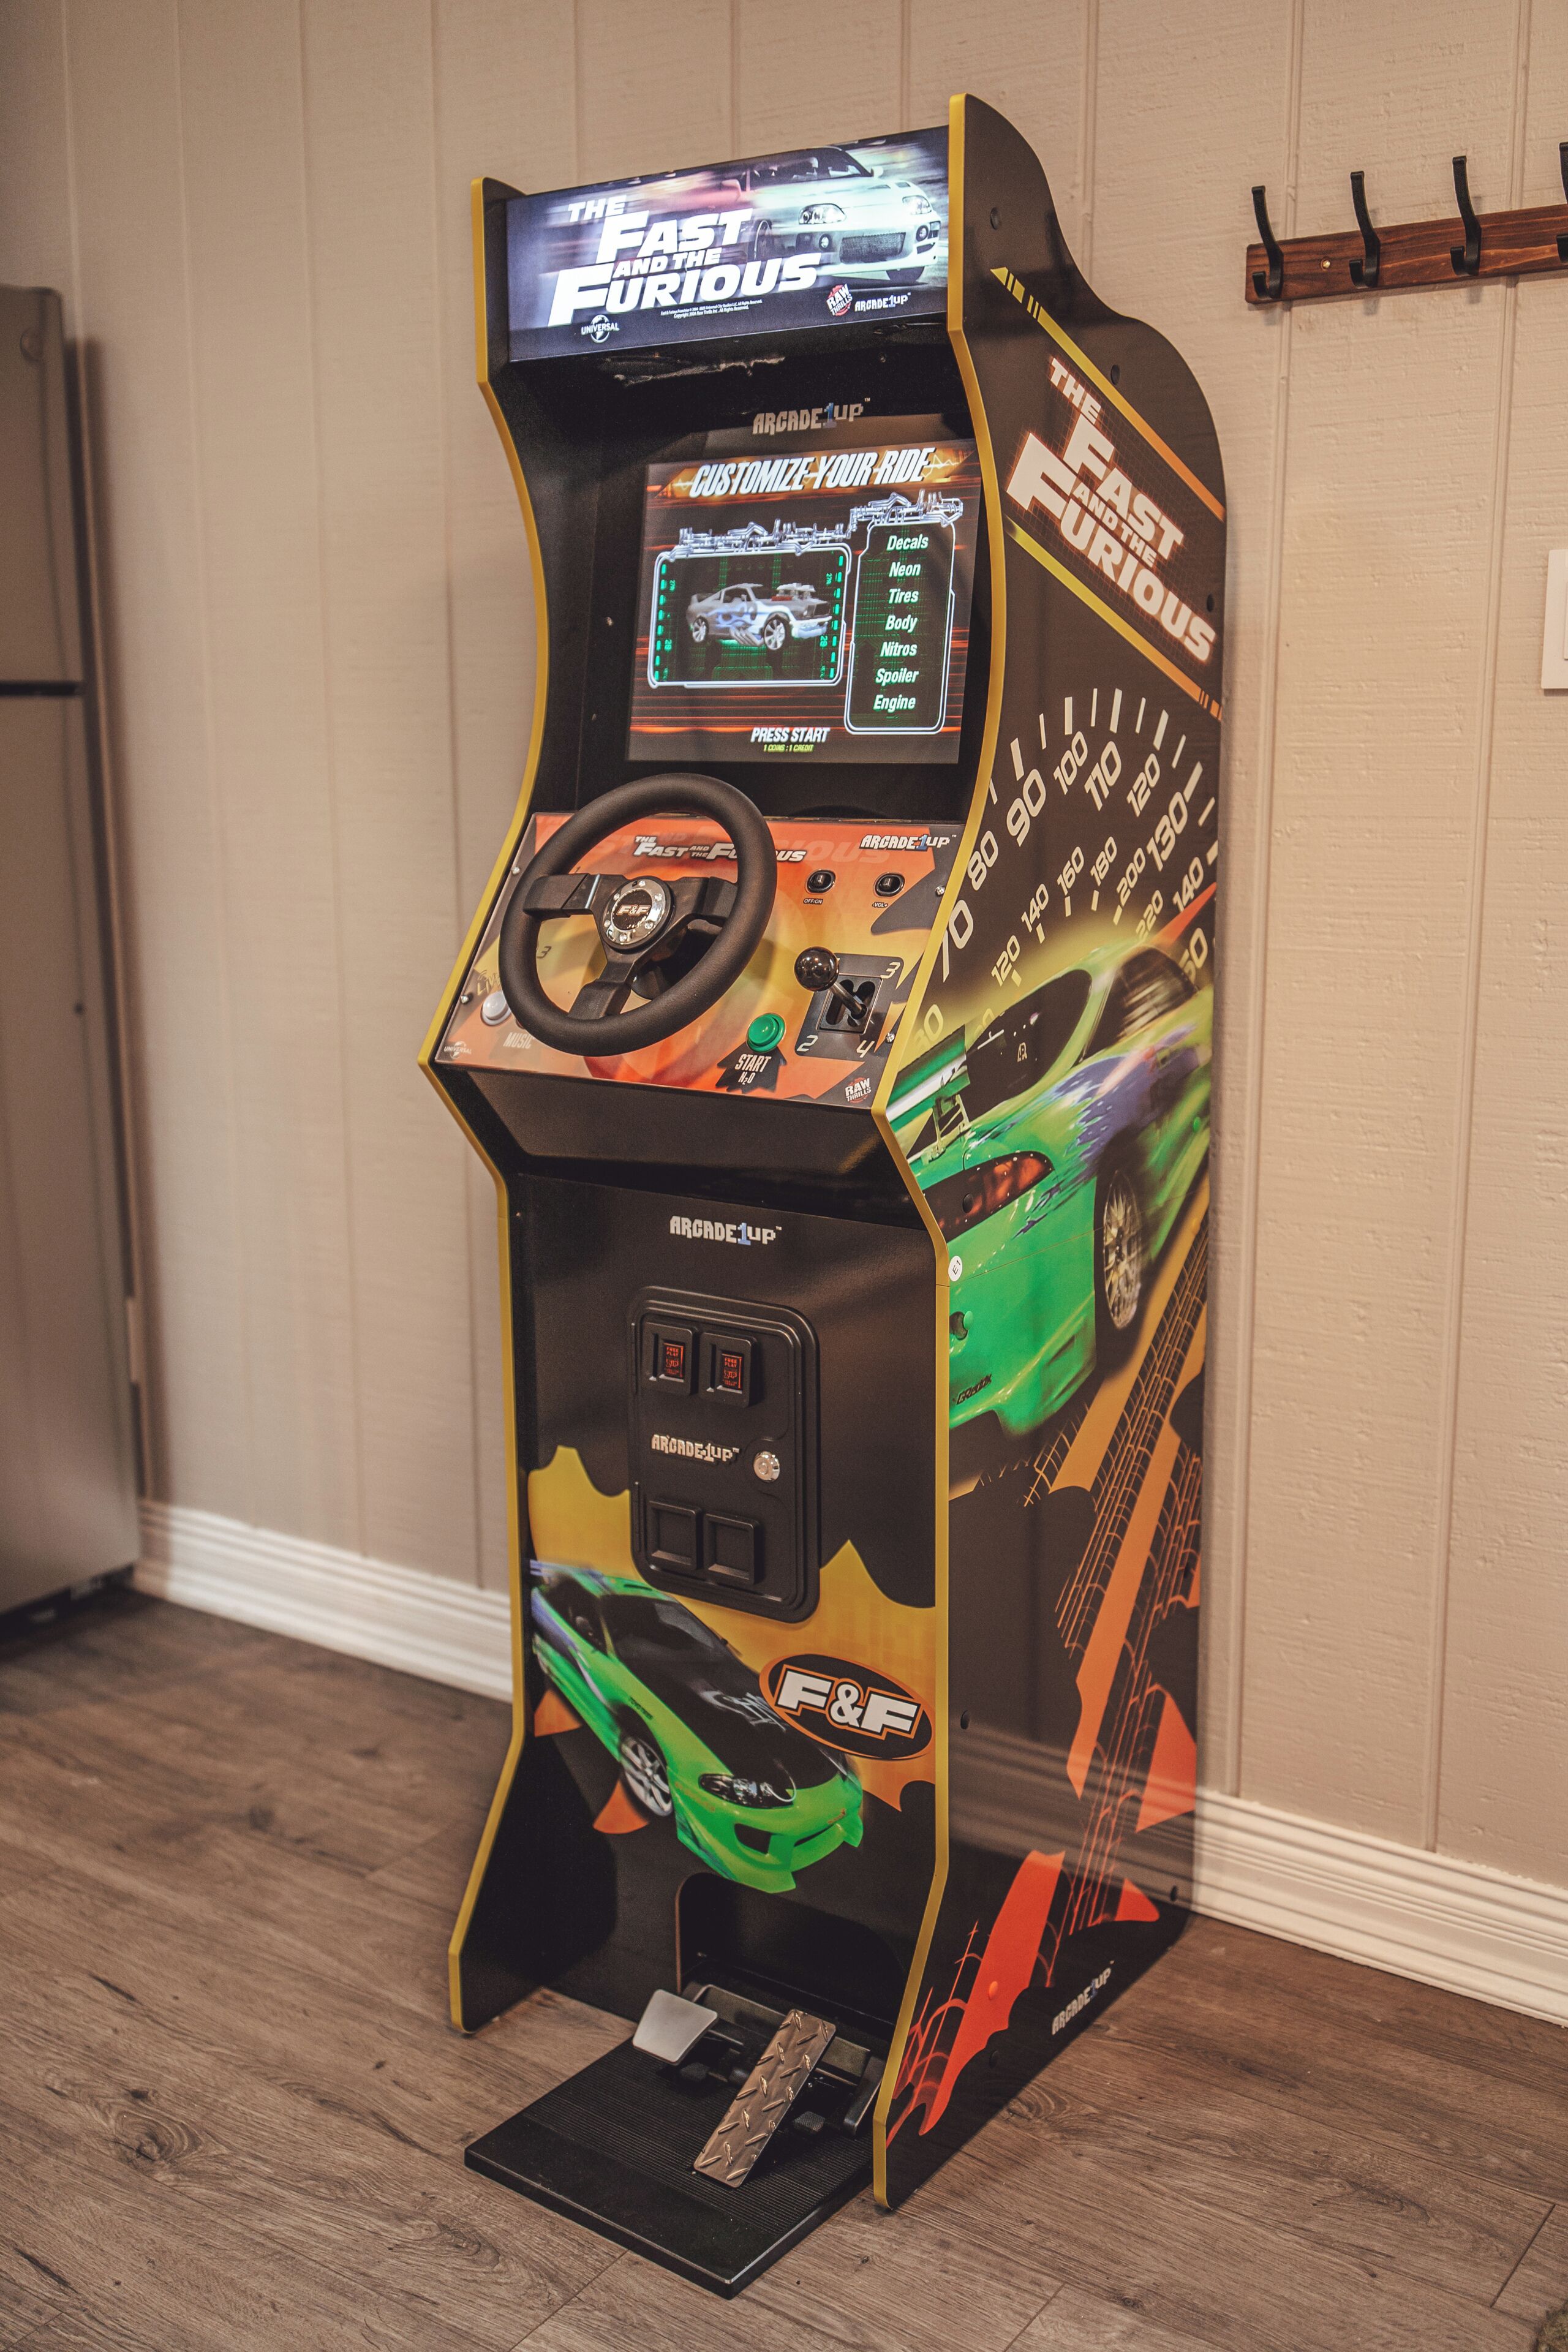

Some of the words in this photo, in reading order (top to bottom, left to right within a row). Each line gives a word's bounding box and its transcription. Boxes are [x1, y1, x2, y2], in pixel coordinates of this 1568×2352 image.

[568, 195, 627, 222] THE
[595, 208, 753, 263] FAST
[612, 256, 668, 279] AND
[672, 247, 722, 268] THE
[548, 252, 821, 327] FURIOUS
[826, 284, 850, 309] RAW
[831, 293, 853, 316] THRILLS
[581, 322, 620, 336] UNIVERSAL
[1049, 358, 1102, 421] THE
[689, 457, 815, 498] CUSTOMIZE
[813, 453, 878, 489] YOUR
[874, 447, 937, 485] RIDE
[1063, 413, 1184, 561] FAST
[1073, 487, 1118, 530] AND
[1120, 524, 1157, 567] THE
[886, 534, 929, 551] Decals
[1006, 432, 1216, 662] FURIOUS
[889, 562, 921, 578] Neon
[889, 589, 919, 604] Tires
[885, 616, 918, 635] Body
[880, 642, 918, 657] Nitros
[875, 668, 919, 687] Spoiler
[873, 695, 916, 713] Engine
[750, 726, 790, 743] PRESS
[790, 726, 831, 743] START
[1054, 731, 1088, 795] 100
[1084, 741, 1122, 811] 110
[1126, 753, 1161, 817] 120
[1006, 769, 1046, 847] 90
[1147, 791, 1188, 872] 130
[634, 842, 690, 857] FAST
[967, 831, 998, 891] 80
[1090, 836, 1117, 886] 180
[1057, 846, 1084, 895] 160
[1117, 847, 1147, 907] 200
[1172, 857, 1204, 912] 140
[616, 904, 651, 917] F&F
[1021, 883, 1049, 932] 140
[1136, 890, 1163, 943] 220
[880, 962, 901, 979] 3
[992, 935, 1020, 986] 120
[443, 1046, 472, 1055] UNIVERSAL
[503, 1032, 535, 1049] MUSIC
[796, 1035, 818, 1052] 2
[856, 1040, 875, 1058] 4
[735, 1054, 772, 1072] START
[845, 1077, 870, 1096] RAW
[846, 1087, 872, 1102] THRILLS
[952, 1260, 960, 1275] E1
[776, 1669, 919, 1733] F&F
